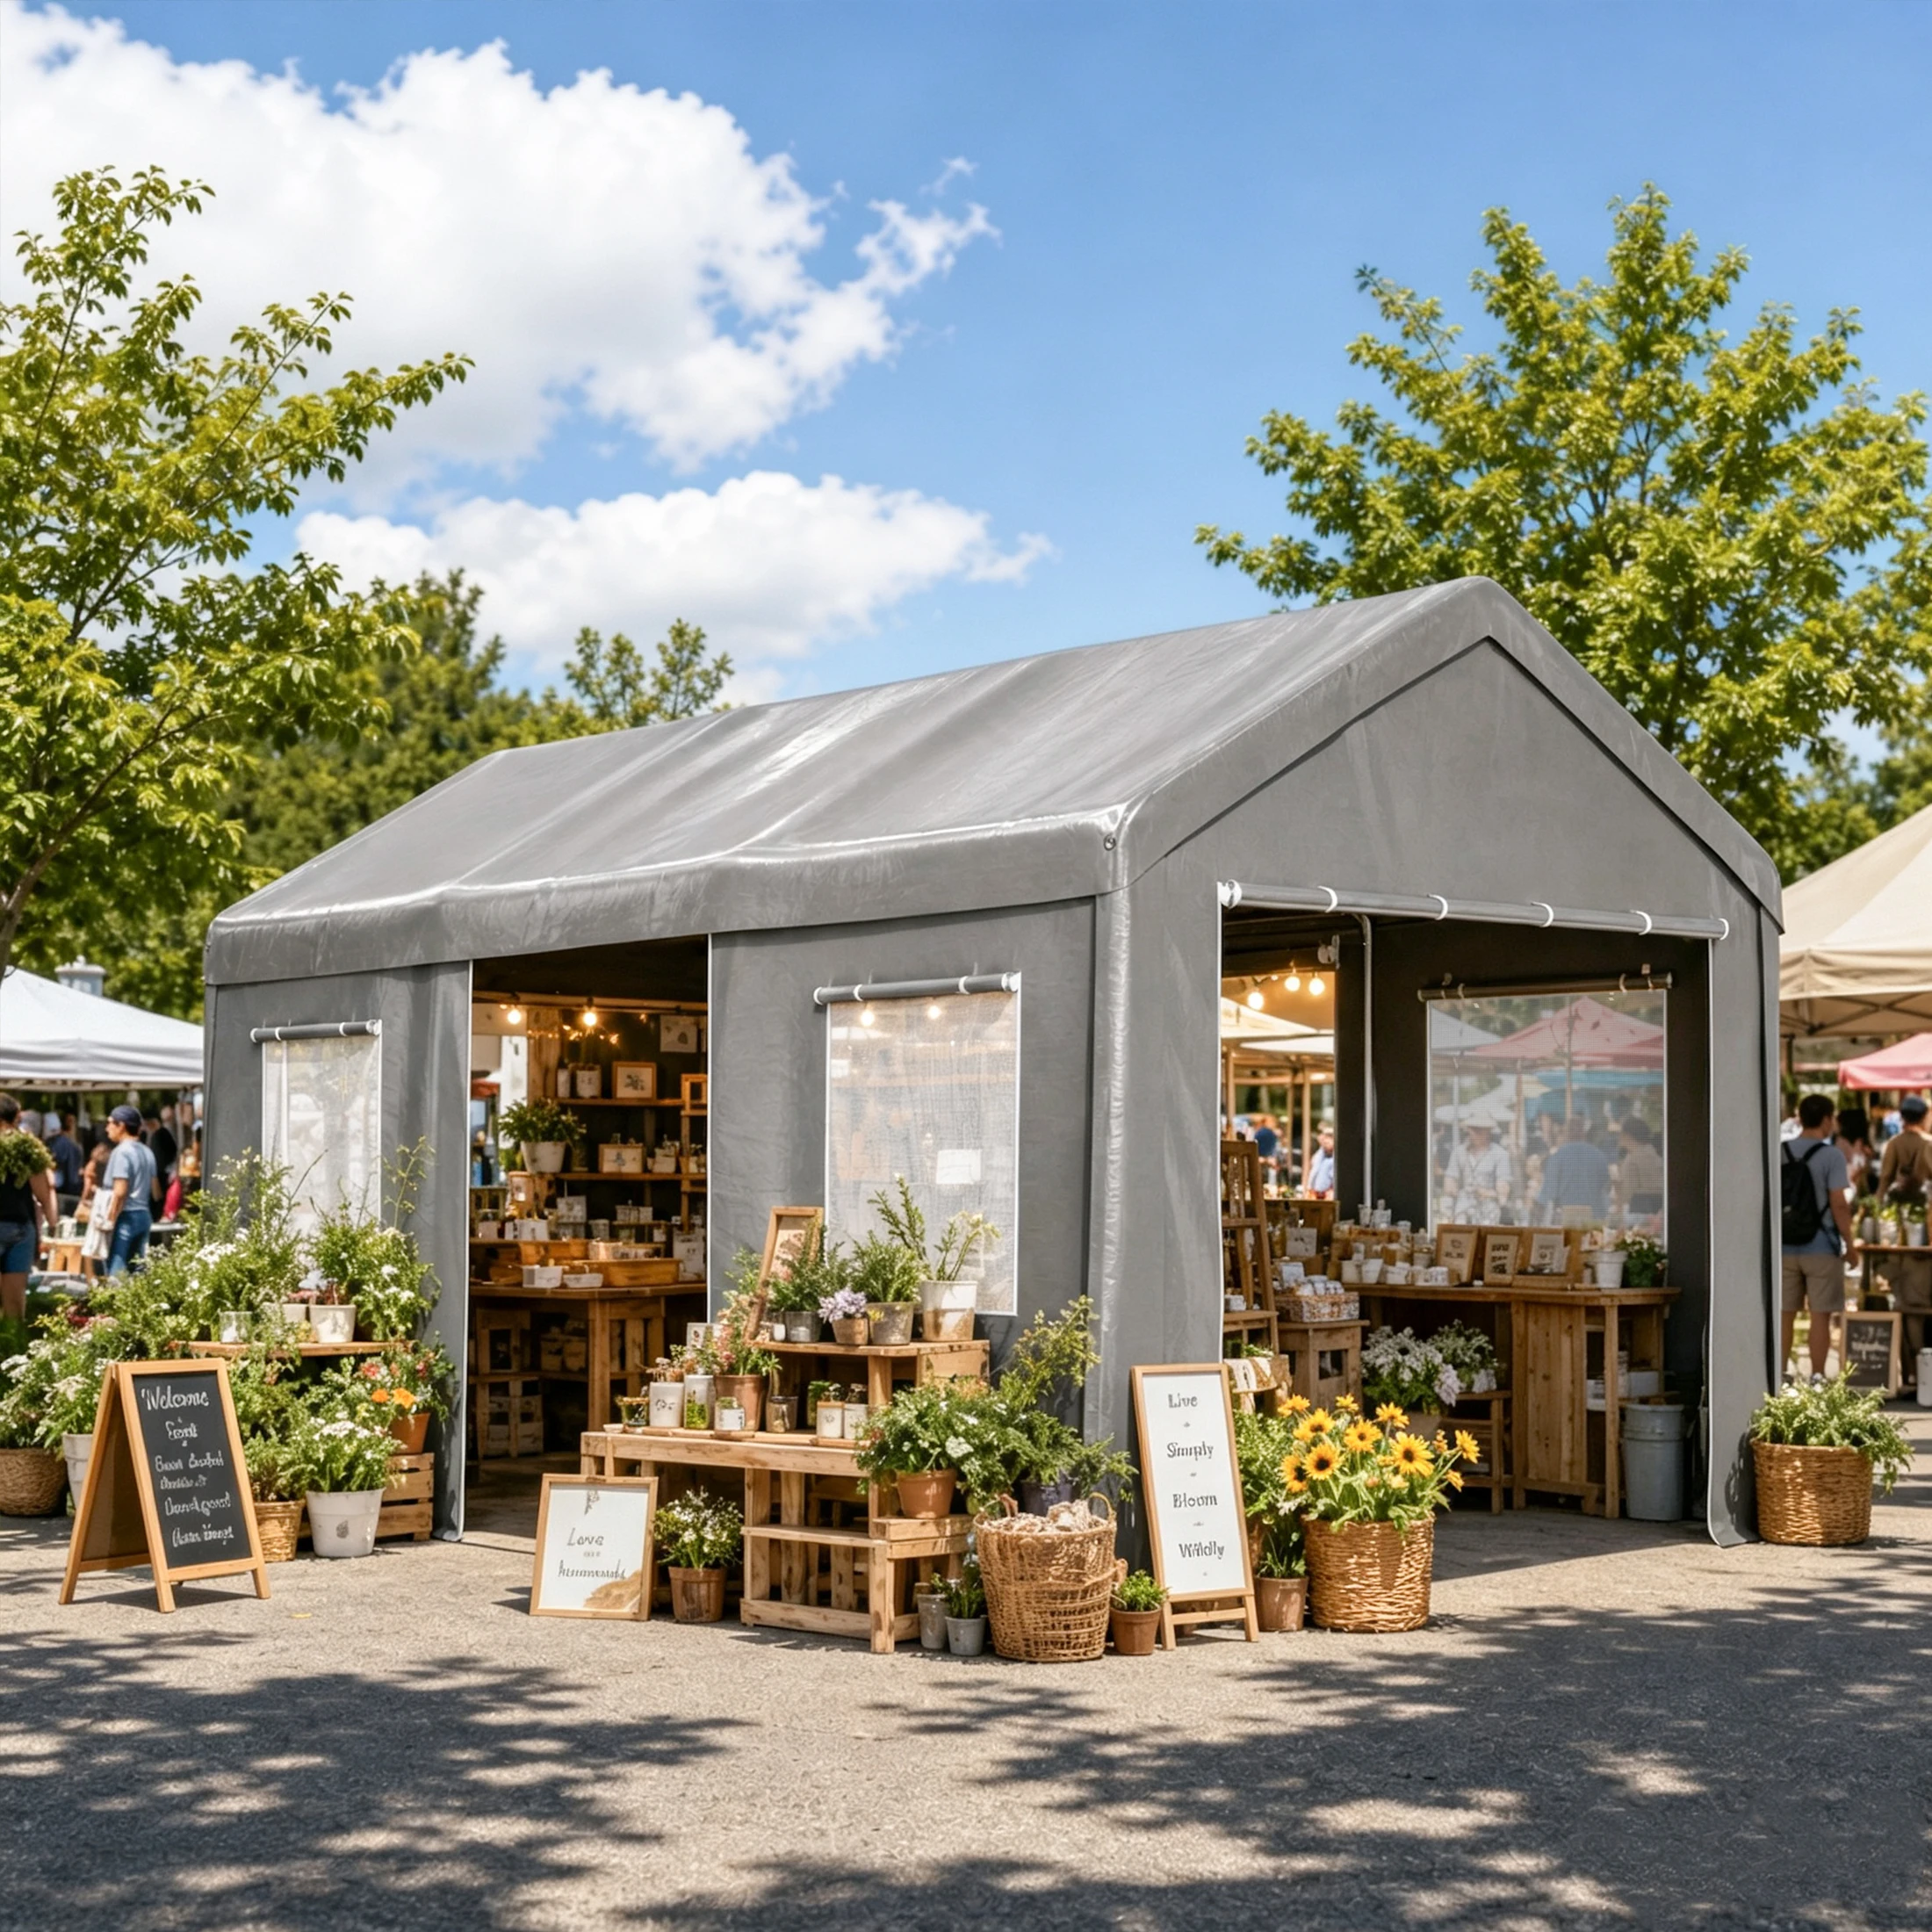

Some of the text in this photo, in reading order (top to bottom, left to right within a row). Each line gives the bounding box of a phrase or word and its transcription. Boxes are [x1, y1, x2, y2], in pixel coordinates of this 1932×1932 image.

[1168, 1393, 1198, 1409] Live
[1166, 1441, 1214, 1461] Simply
[1172, 1492, 1218, 1508] Bloom
[566, 1527, 604, 1546] Love
[1179, 1540, 1225, 1560] Wildly
